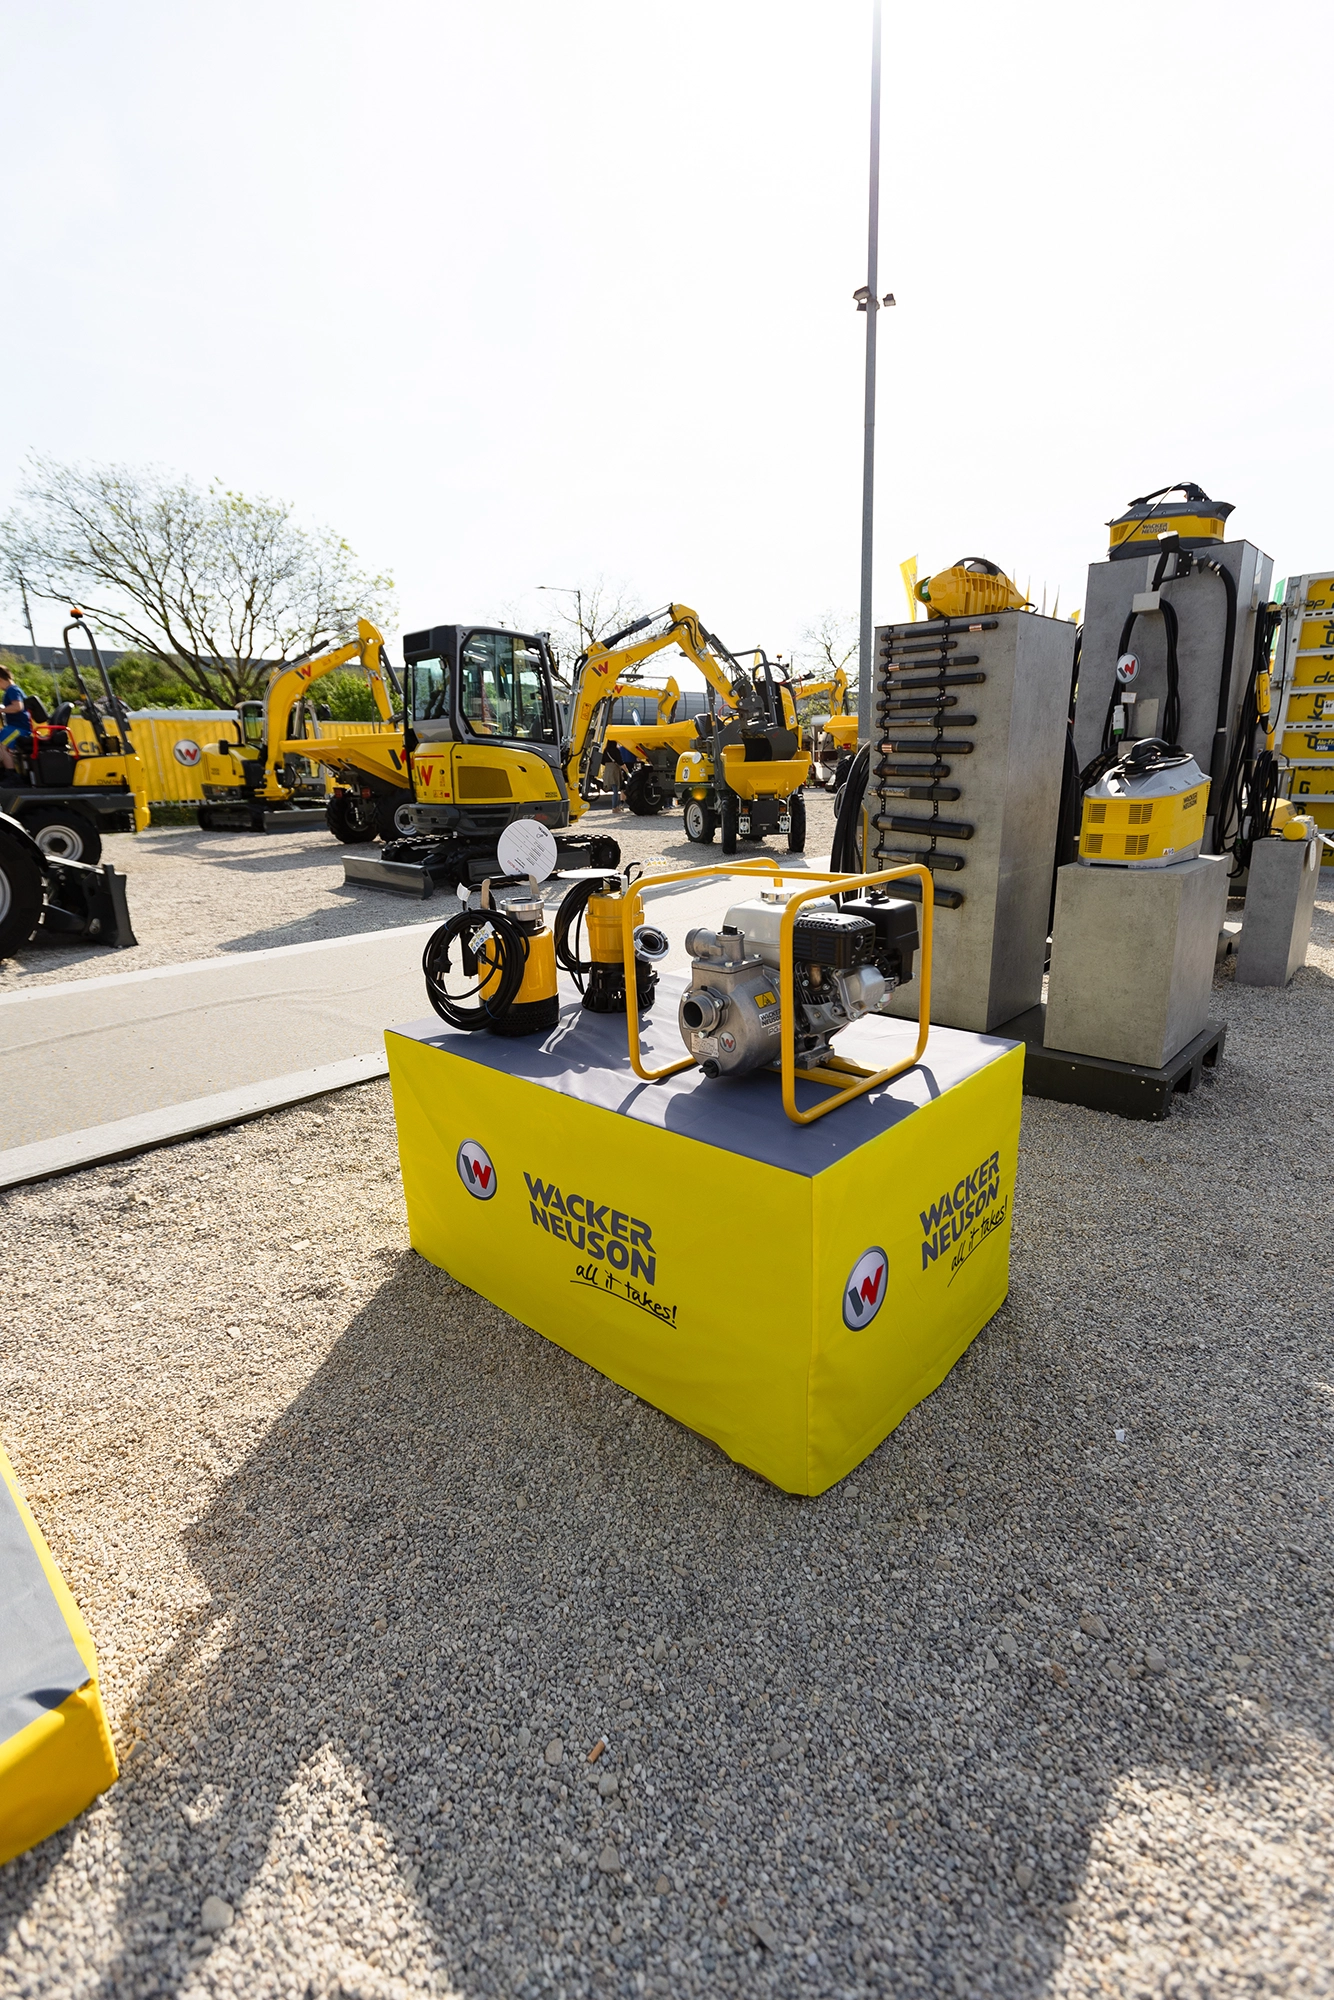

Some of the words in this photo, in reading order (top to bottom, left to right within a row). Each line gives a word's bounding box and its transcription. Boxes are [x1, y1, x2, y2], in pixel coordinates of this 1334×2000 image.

[762, 1015, 781, 1027] NEUSO
[522, 1171, 657, 1255] WACKER
[919, 1150, 1001, 1237] WACKER
[921, 1175, 1001, 1272] NEUSON
[951, 1240, 967, 1272] all
[968, 1227, 980, 1252] it
[981, 1194, 1009, 1239] takes!
[528, 1200, 656, 1287] NEUSON
[576, 1263, 599, 1285] all
[604, 1269, 622, 1291] it
[625, 1281, 678, 1324] takes!
